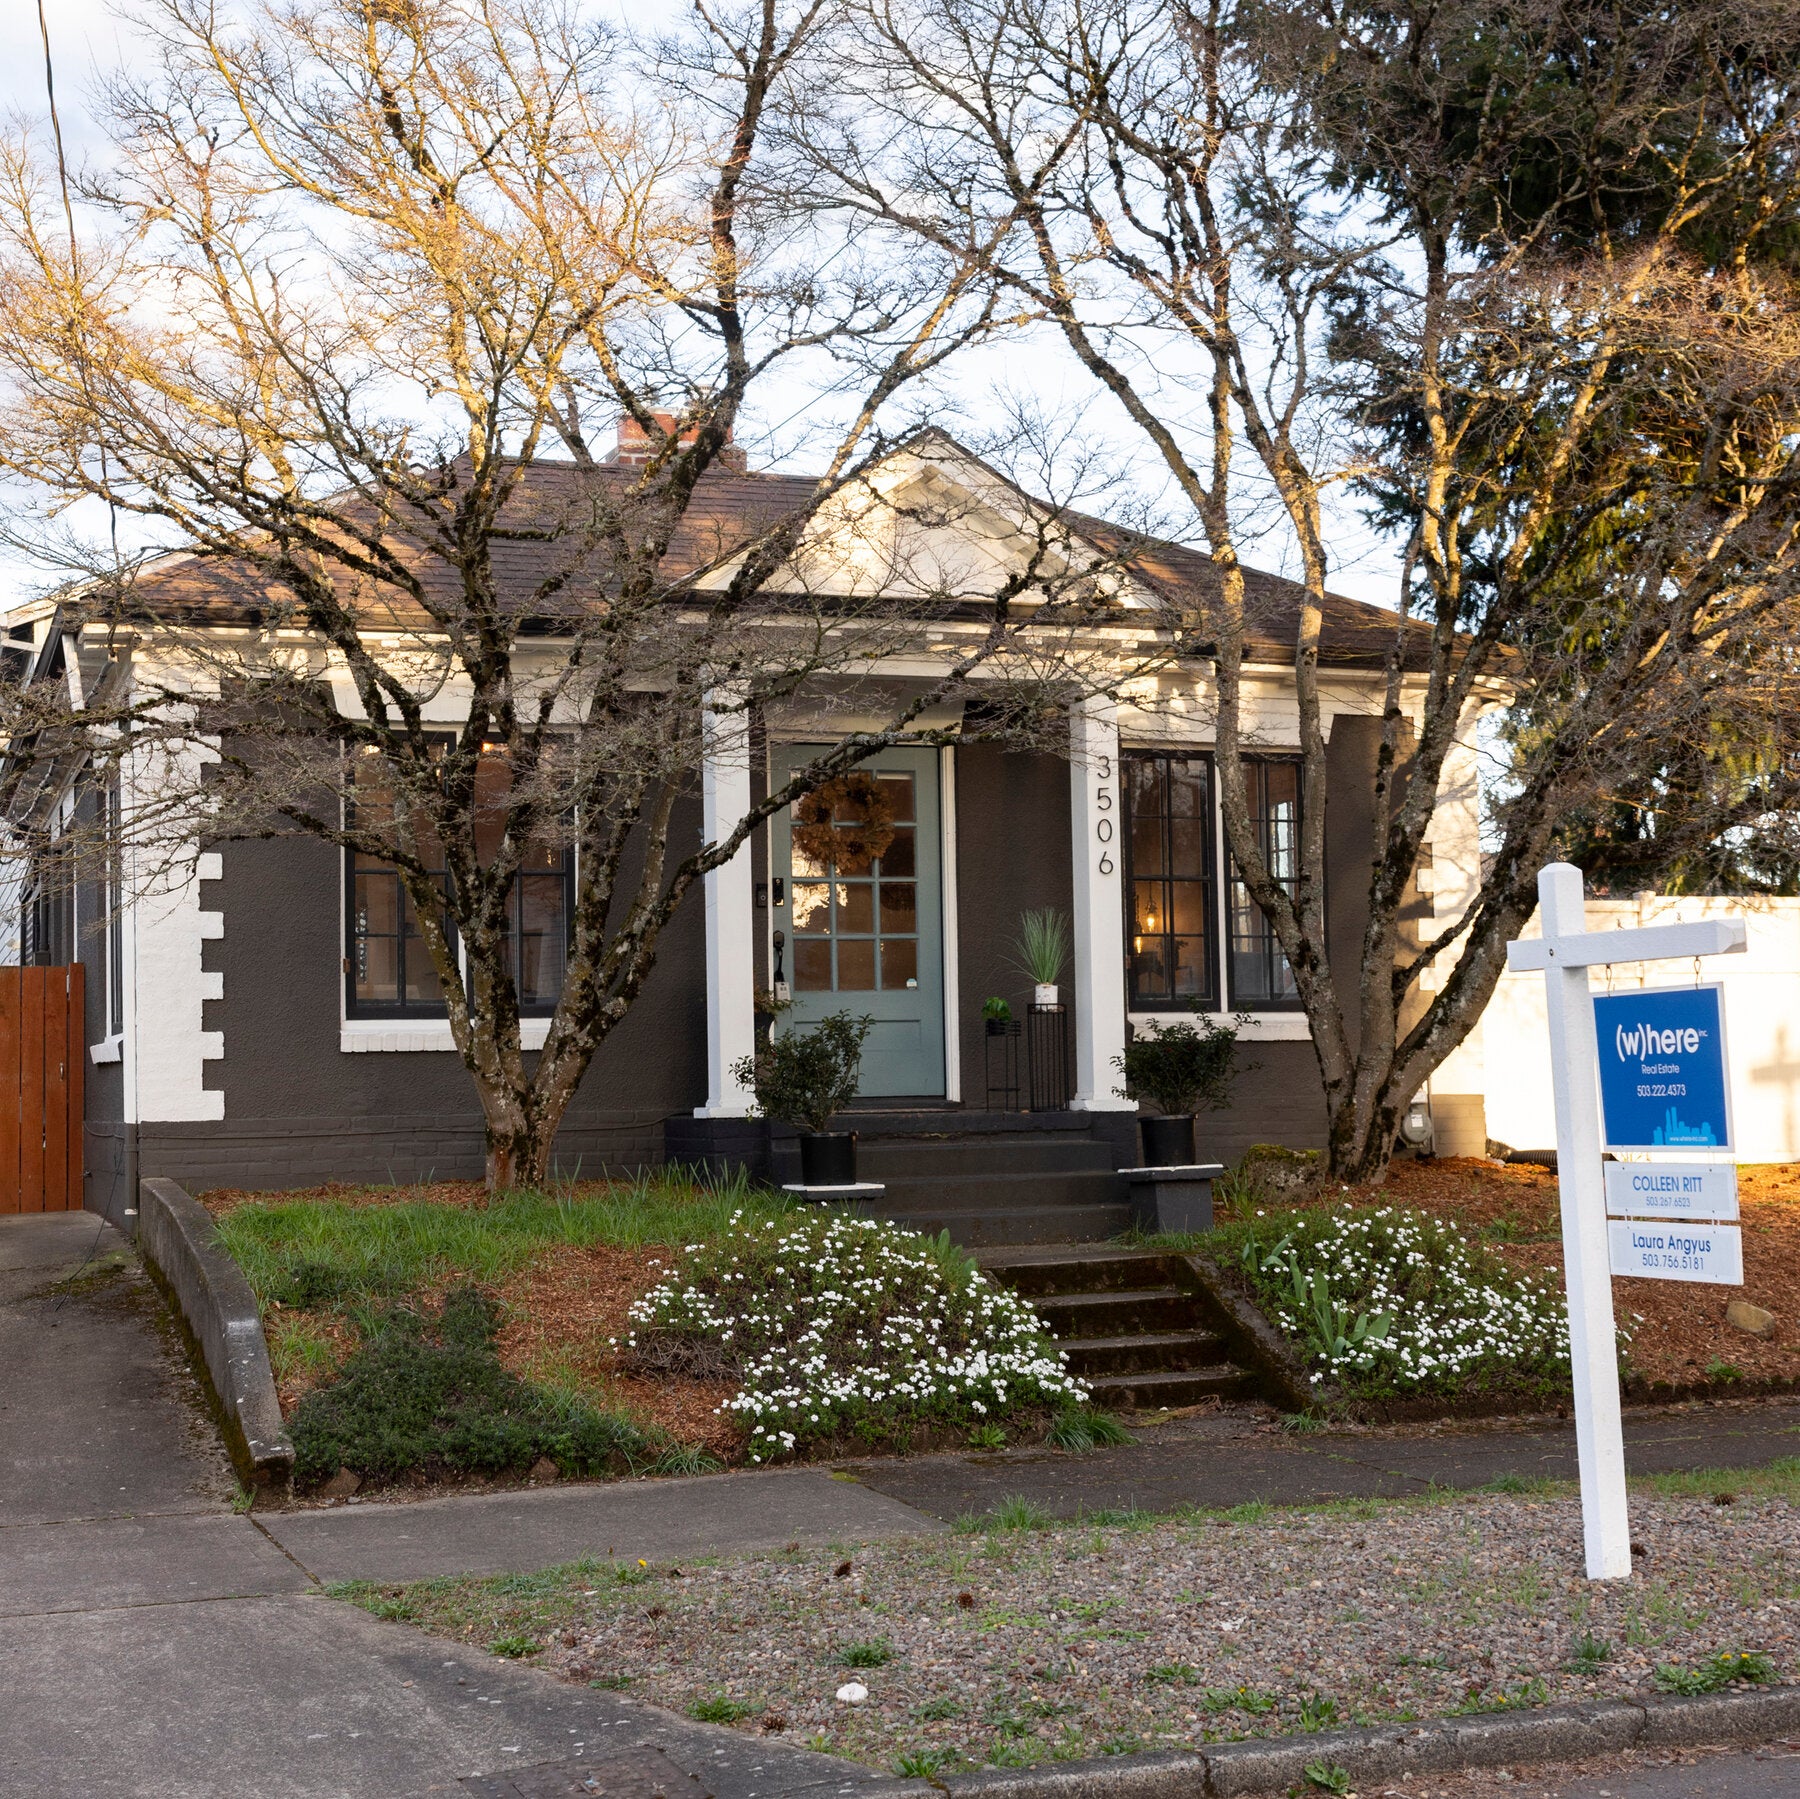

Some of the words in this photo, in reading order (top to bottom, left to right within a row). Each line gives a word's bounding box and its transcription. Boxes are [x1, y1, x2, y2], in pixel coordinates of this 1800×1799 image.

[1097, 755, 1114, 875] 3506
[1616, 1023, 1700, 1062] (w)here
[1641, 1064, 1657, 1075] Real
[1658, 1063, 1680, 1074] Estate
[1637, 1084, 1686, 1097] 503.222.4373
[1632, 1175, 1680, 1192] COLLEEN
[1683, 1177, 1703, 1192] RITT
[1646, 1196, 1690, 1208] 503.267.6523
[1632, 1232, 1664, 1249] Laura
[1667, 1235, 1711, 1255] Angyus
[1642, 1253, 1704, 1270] 503.756.5181
